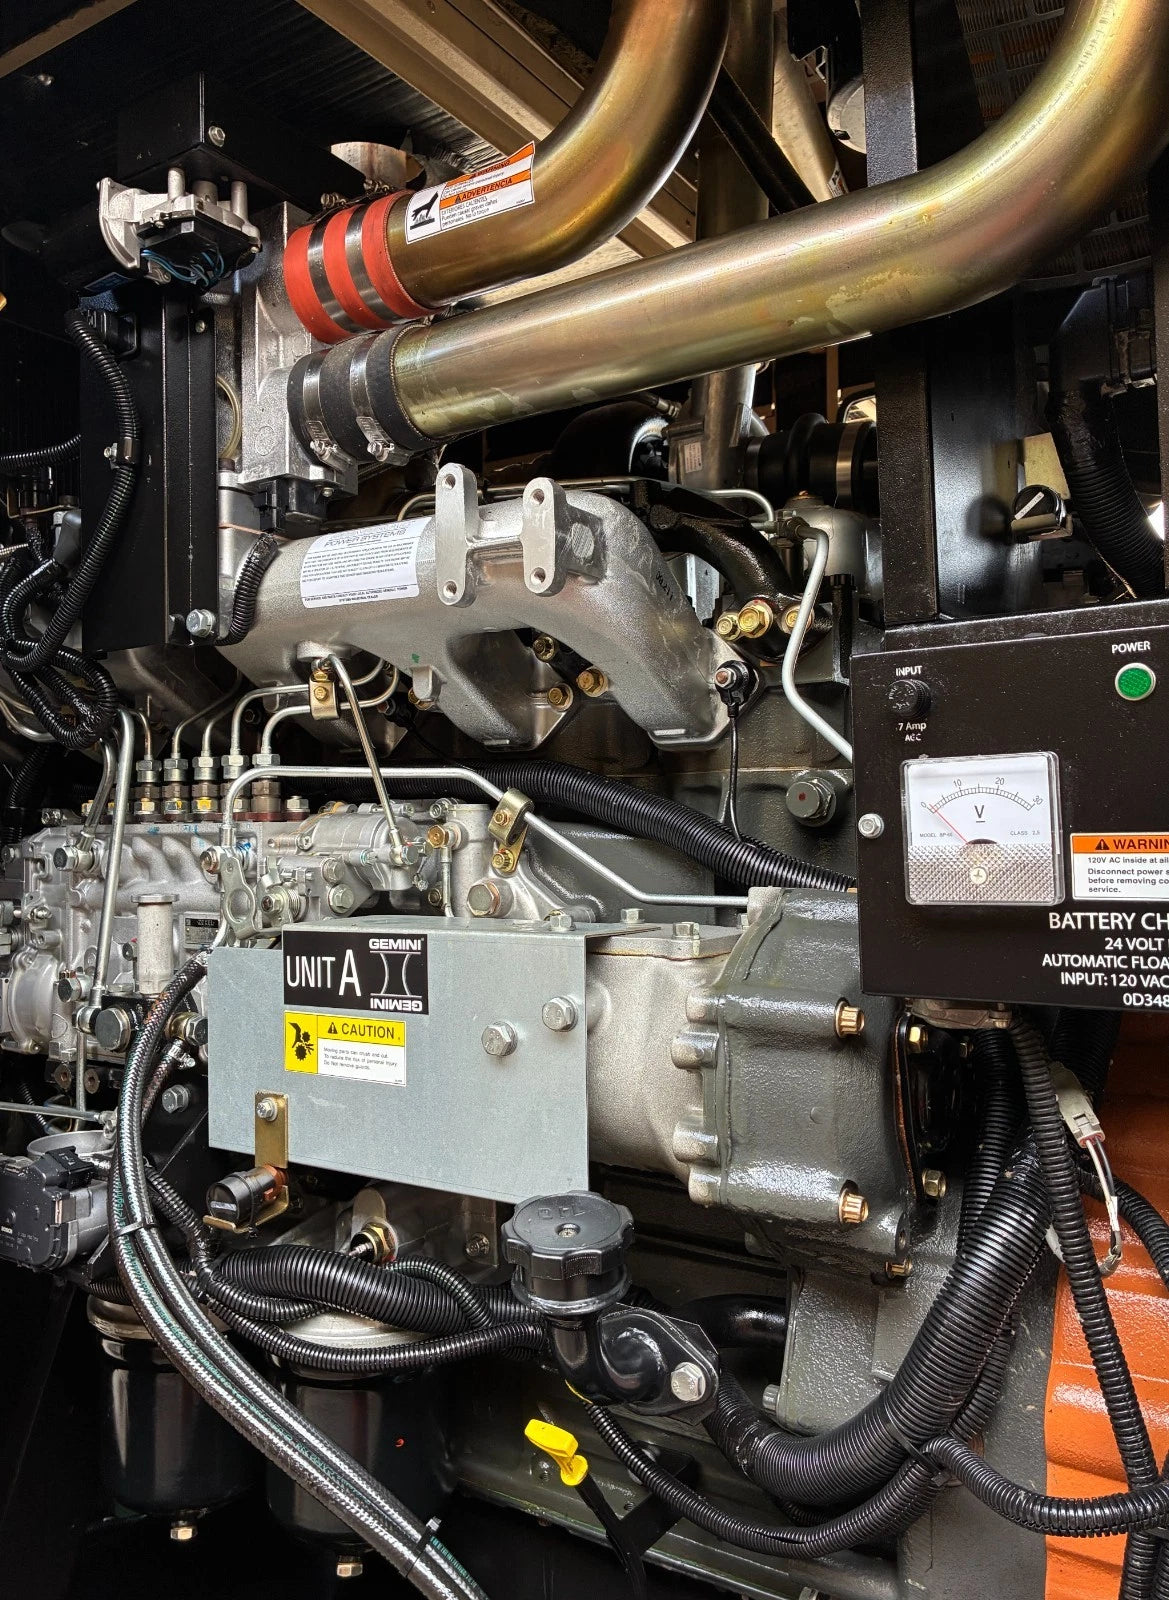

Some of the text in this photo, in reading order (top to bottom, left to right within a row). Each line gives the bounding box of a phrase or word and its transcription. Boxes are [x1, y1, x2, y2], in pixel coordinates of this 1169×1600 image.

[462, 178, 512, 200] ADVERTENCIA
[1111, 640, 1151, 654] POWER
[895, 665, 922, 676] INPUT
[905, 722, 927, 731] Amp
[953, 778, 962, 787] 10
[995, 777, 1005, 785] 20
[1032, 795, 1043, 805] 30
[974, 805, 985, 818] V
[1117, 878, 1156, 886] removing
[1049, 912, 1136, 930] BATTERY
[369, 938, 422, 951] GEMINI
[1105, 937, 1123, 950] 24
[1125, 937, 1164, 951] VOLT
[1042, 953, 1128, 968] AUTOMATIC
[286, 949, 362, 997] UNIT A
[1060, 972, 1169, 989] INPUT: 120 VAC
[370, 997, 423, 1012] GEMINI
[341, 1023, 395, 1040] CAUTION
